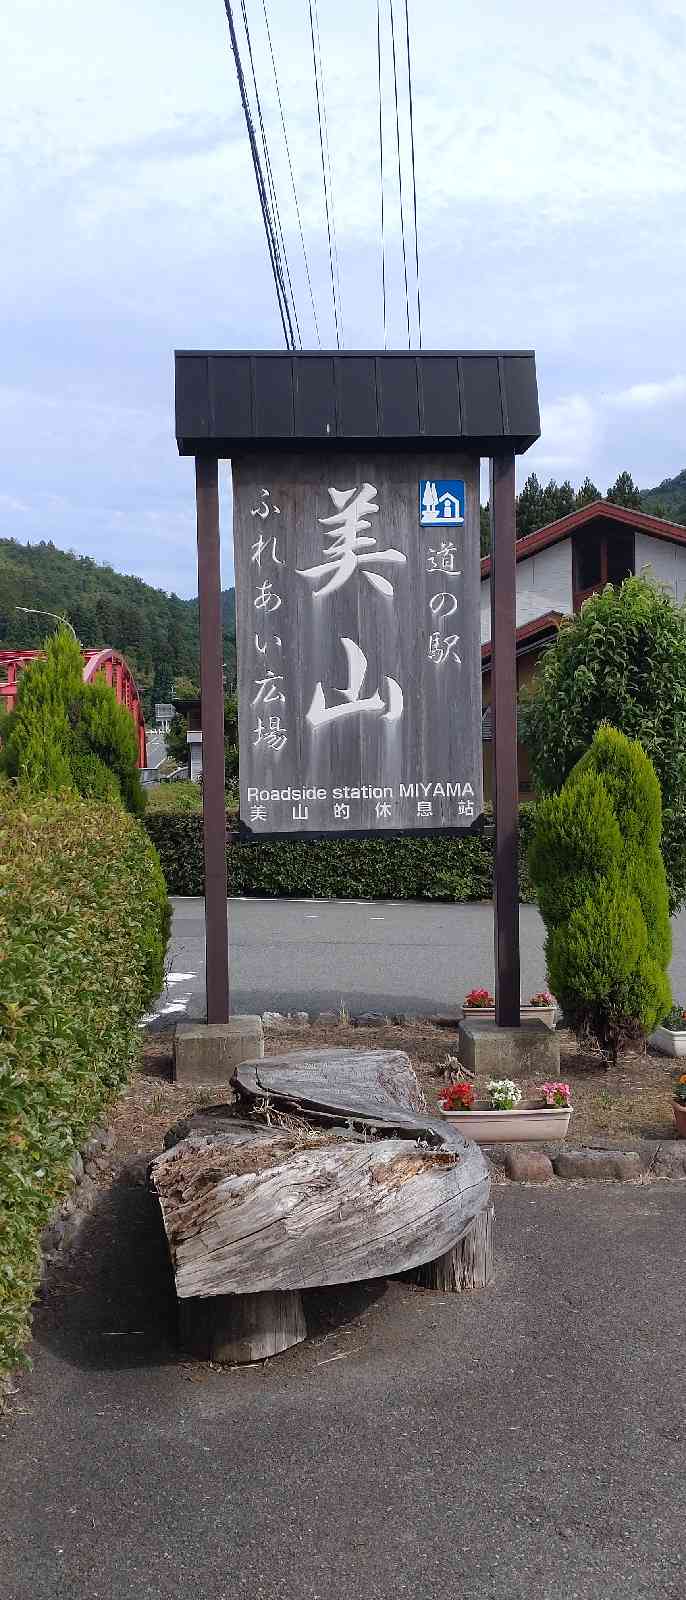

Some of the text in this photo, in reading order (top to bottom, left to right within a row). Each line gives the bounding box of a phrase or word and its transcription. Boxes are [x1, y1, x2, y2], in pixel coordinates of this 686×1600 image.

[251, 488, 287, 751] ふれあい広場
[295, 482, 407, 728] 美山
[427, 542, 462, 665] 道の駅
[247, 782, 474, 801] Roadside station MIYAMA
[250, 800, 474, 822] 美山的休息站
